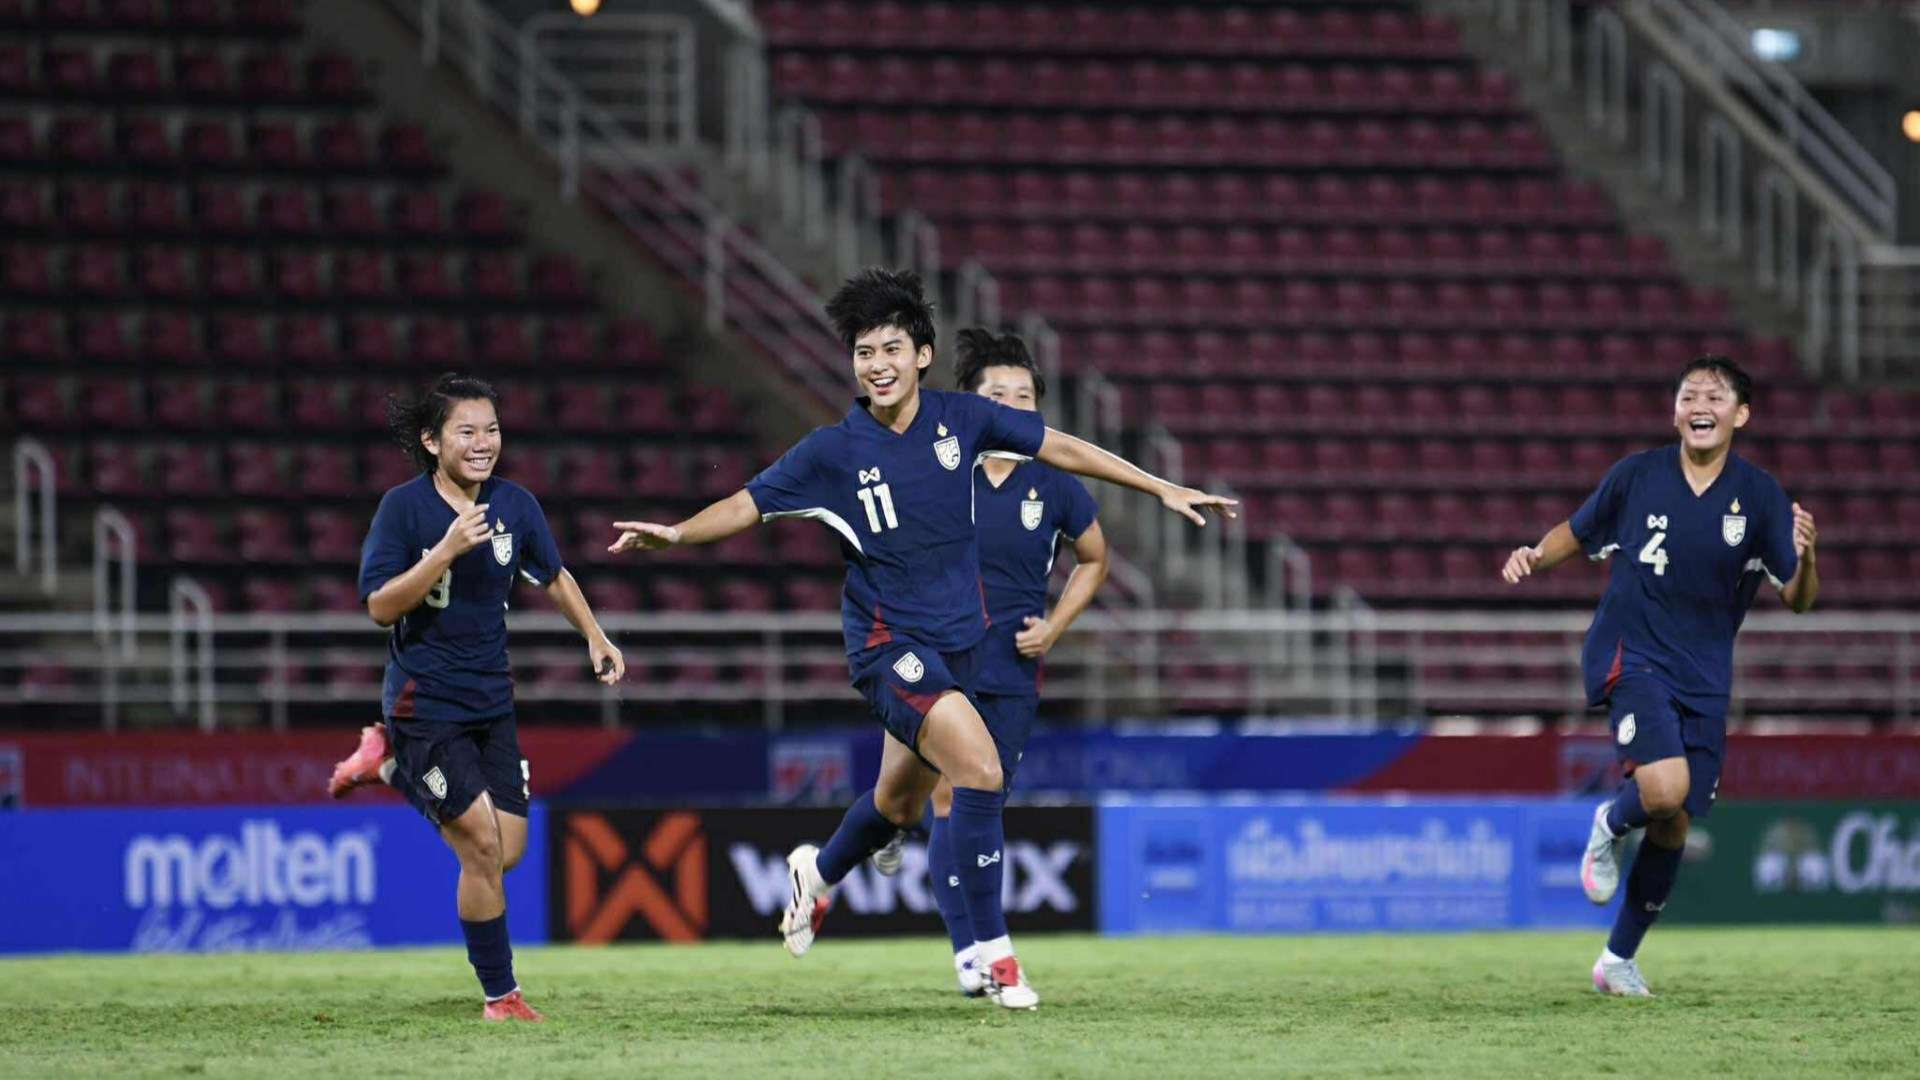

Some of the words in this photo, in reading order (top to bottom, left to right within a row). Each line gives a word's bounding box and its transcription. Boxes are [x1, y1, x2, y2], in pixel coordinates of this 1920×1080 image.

[857, 483, 899, 533] 11
[1638, 532, 1670, 576] 4
[126, 819, 376, 909] molten
